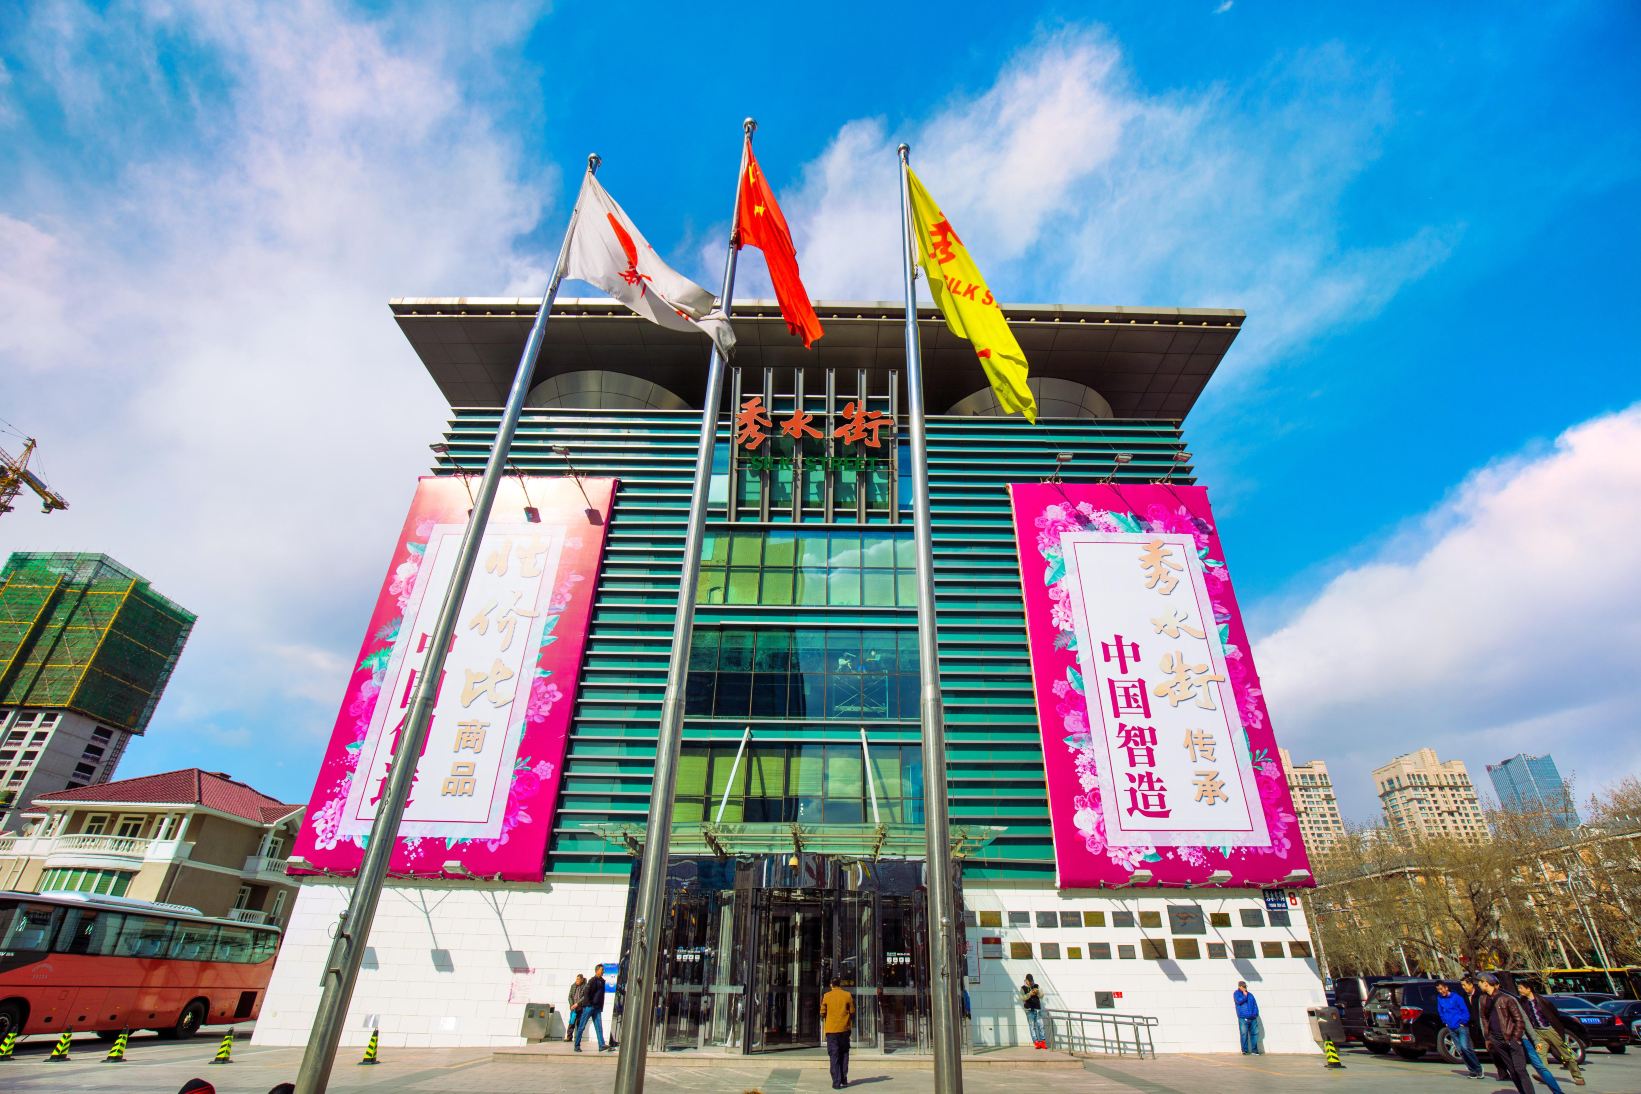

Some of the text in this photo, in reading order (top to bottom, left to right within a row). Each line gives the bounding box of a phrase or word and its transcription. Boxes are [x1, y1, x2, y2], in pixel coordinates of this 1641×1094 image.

[736, 396, 894, 449] 秀水街
[751, 455, 878, 472] SILK STREET
[441, 538, 549, 798] 性价比商品
[1101, 634, 1172, 819] 中国智造
[1138, 539, 1229, 806] 秀水街传承
